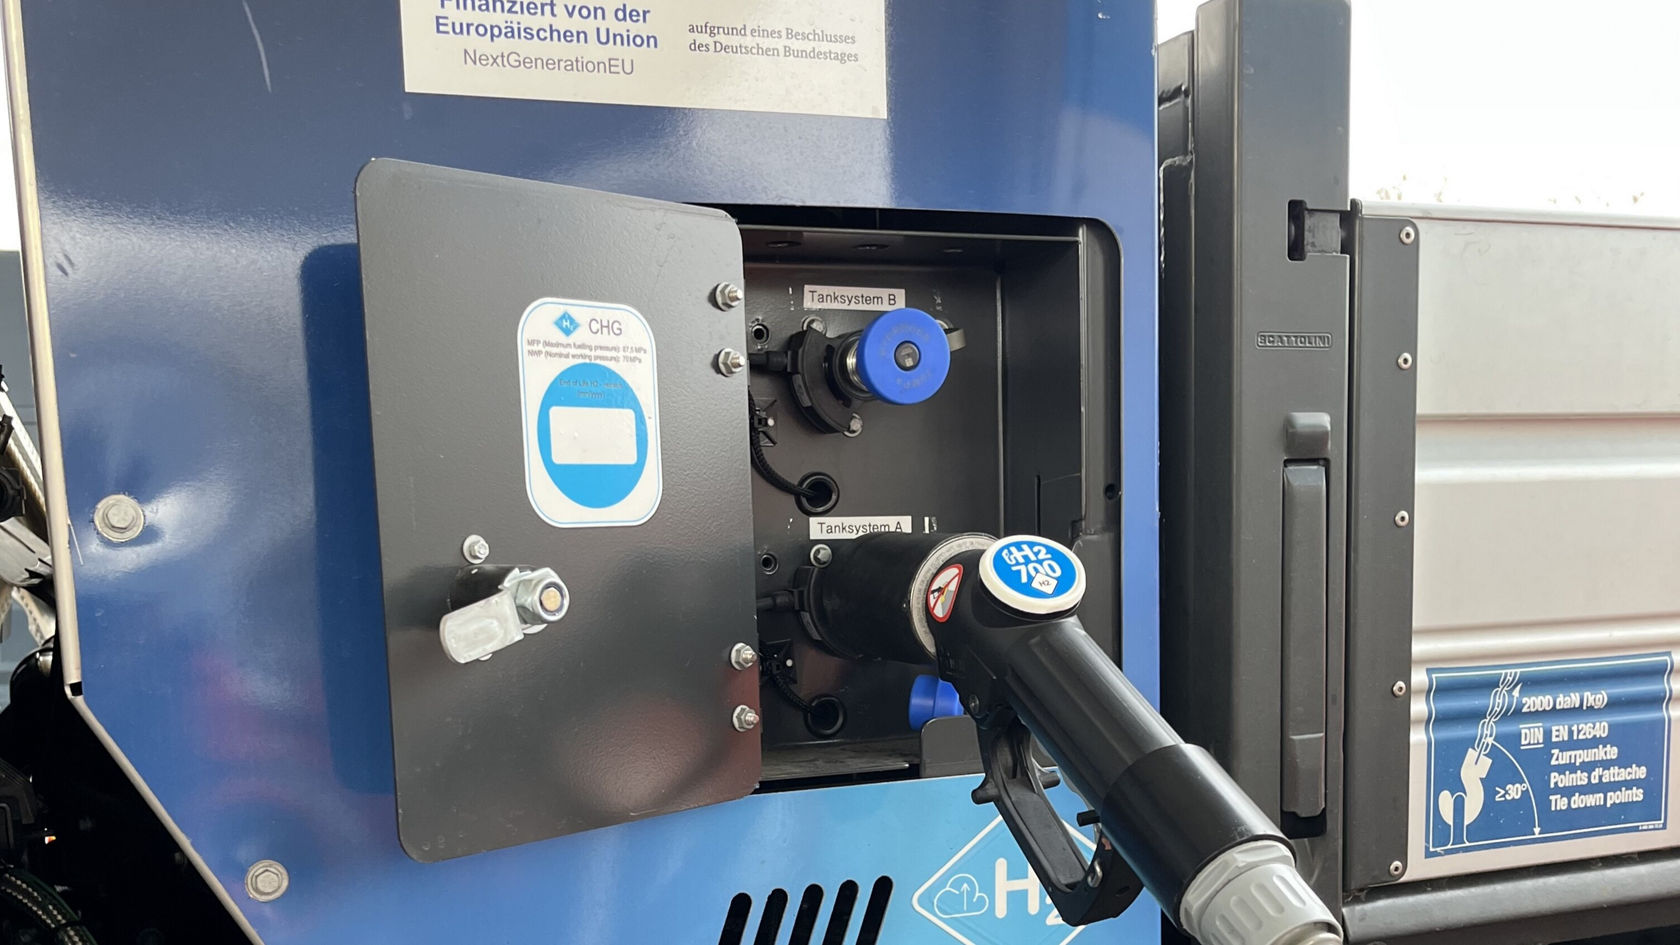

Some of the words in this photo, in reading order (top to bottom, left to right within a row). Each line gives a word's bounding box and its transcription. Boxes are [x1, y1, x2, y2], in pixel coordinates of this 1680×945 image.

[564, 3, 606, 21] von
[613, 3, 651, 24] der
[435, 15, 588, 44] Europäischen
[596, 27, 658, 49] Union
[688, 21, 747, 38] aufgrund
[750, 25, 783, 40] eines
[785, 27, 857, 45] Beschlusses
[463, 48, 635, 76] NextGenerationEU
[688, 39, 711, 53] des
[713, 40, 780, 58] Deutschen
[783, 45, 860, 65] Bundestages
[808, 290, 884, 306] Tanksystem
[888, 293, 897, 306] B
[588, 318, 623, 336] CHG
[527, 338, 542, 347] MFP
[542, 339, 572, 349] (Maximum
[635, 345, 648, 354] MPa
[1258, 335, 1329, 347] SCATTOLINI
[528, 350, 543, 358] NWP
[544, 350, 570, 359] (Nominal
[571, 352, 593, 362] working
[817, 522, 890, 535] Tanksystem
[894, 521, 904, 532] A
[1011, 560, 1062, 584] 700
[1038, 579, 1052, 588] H2
[1522, 695, 1554, 713] 2000
[1556, 692, 1580, 709] daN
[1583, 690, 1608, 710] (kg)
[1520, 726, 1544, 745] DIN
[1551, 725, 1569, 742] EN
[1571, 722, 1609, 740] 12640
[1551, 744, 1618, 766] Zurrpunkte
[1550, 770, 1588, 789] Points
[1591, 764, 1647, 785] d'attache
[1549, 795, 1568, 811] Tie
[1570, 791, 1604, 809] down
[1606, 788, 1644, 807] points
